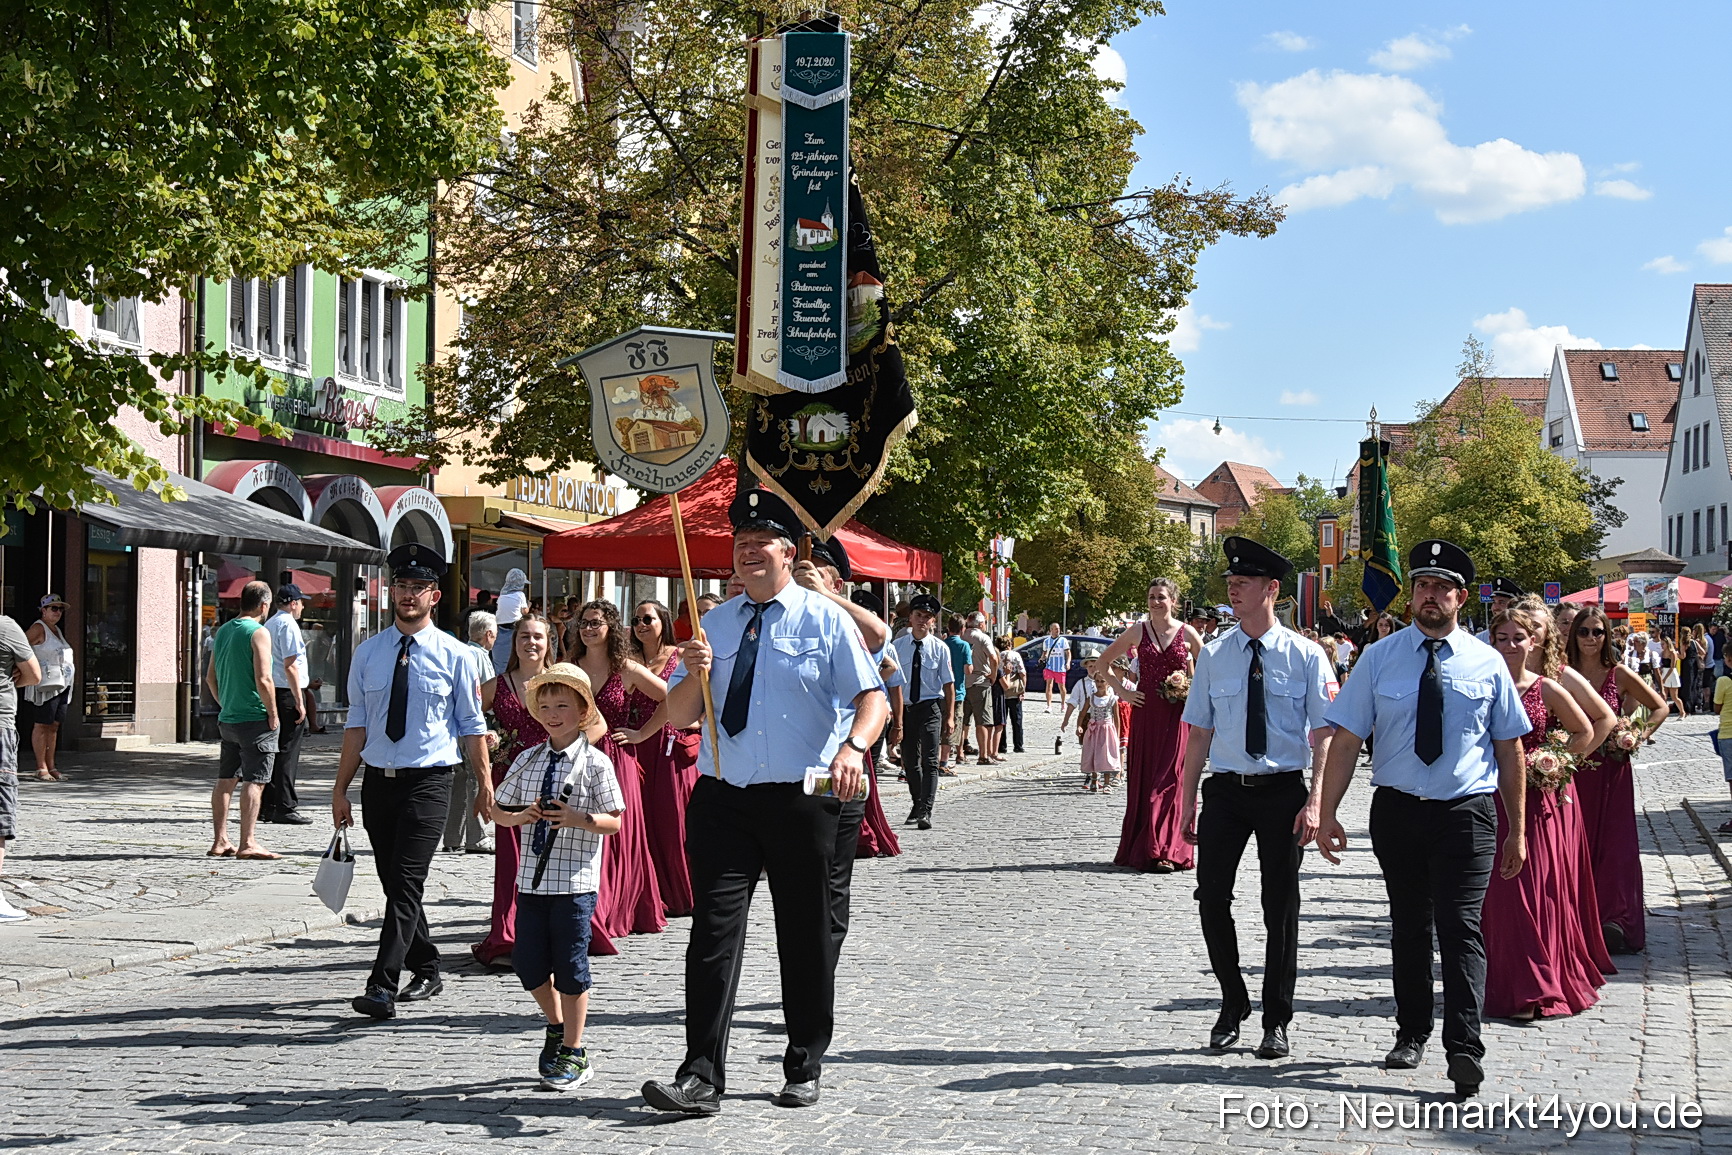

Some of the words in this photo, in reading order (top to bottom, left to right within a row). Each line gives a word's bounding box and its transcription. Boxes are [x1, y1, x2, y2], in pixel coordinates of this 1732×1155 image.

[795, 56, 836, 68] 19.7.2020
[804, 132, 826, 145] Zum
[790, 149, 839, 164] 125-jährigen
[806, 179, 822, 195] fest
[797, 259, 827, 272] gewidmet
[790, 280, 834, 292] Patenverein
[792, 296, 832, 313] Freiwillige
[792, 310, 832, 323] Feuerwehr
[514, 471, 553, 507] LEDER
[556, 475, 622, 517] ROMSTOCK
[90, 524, 112, 544] Essig
[1545, 597, 1560, 605] TAXI
